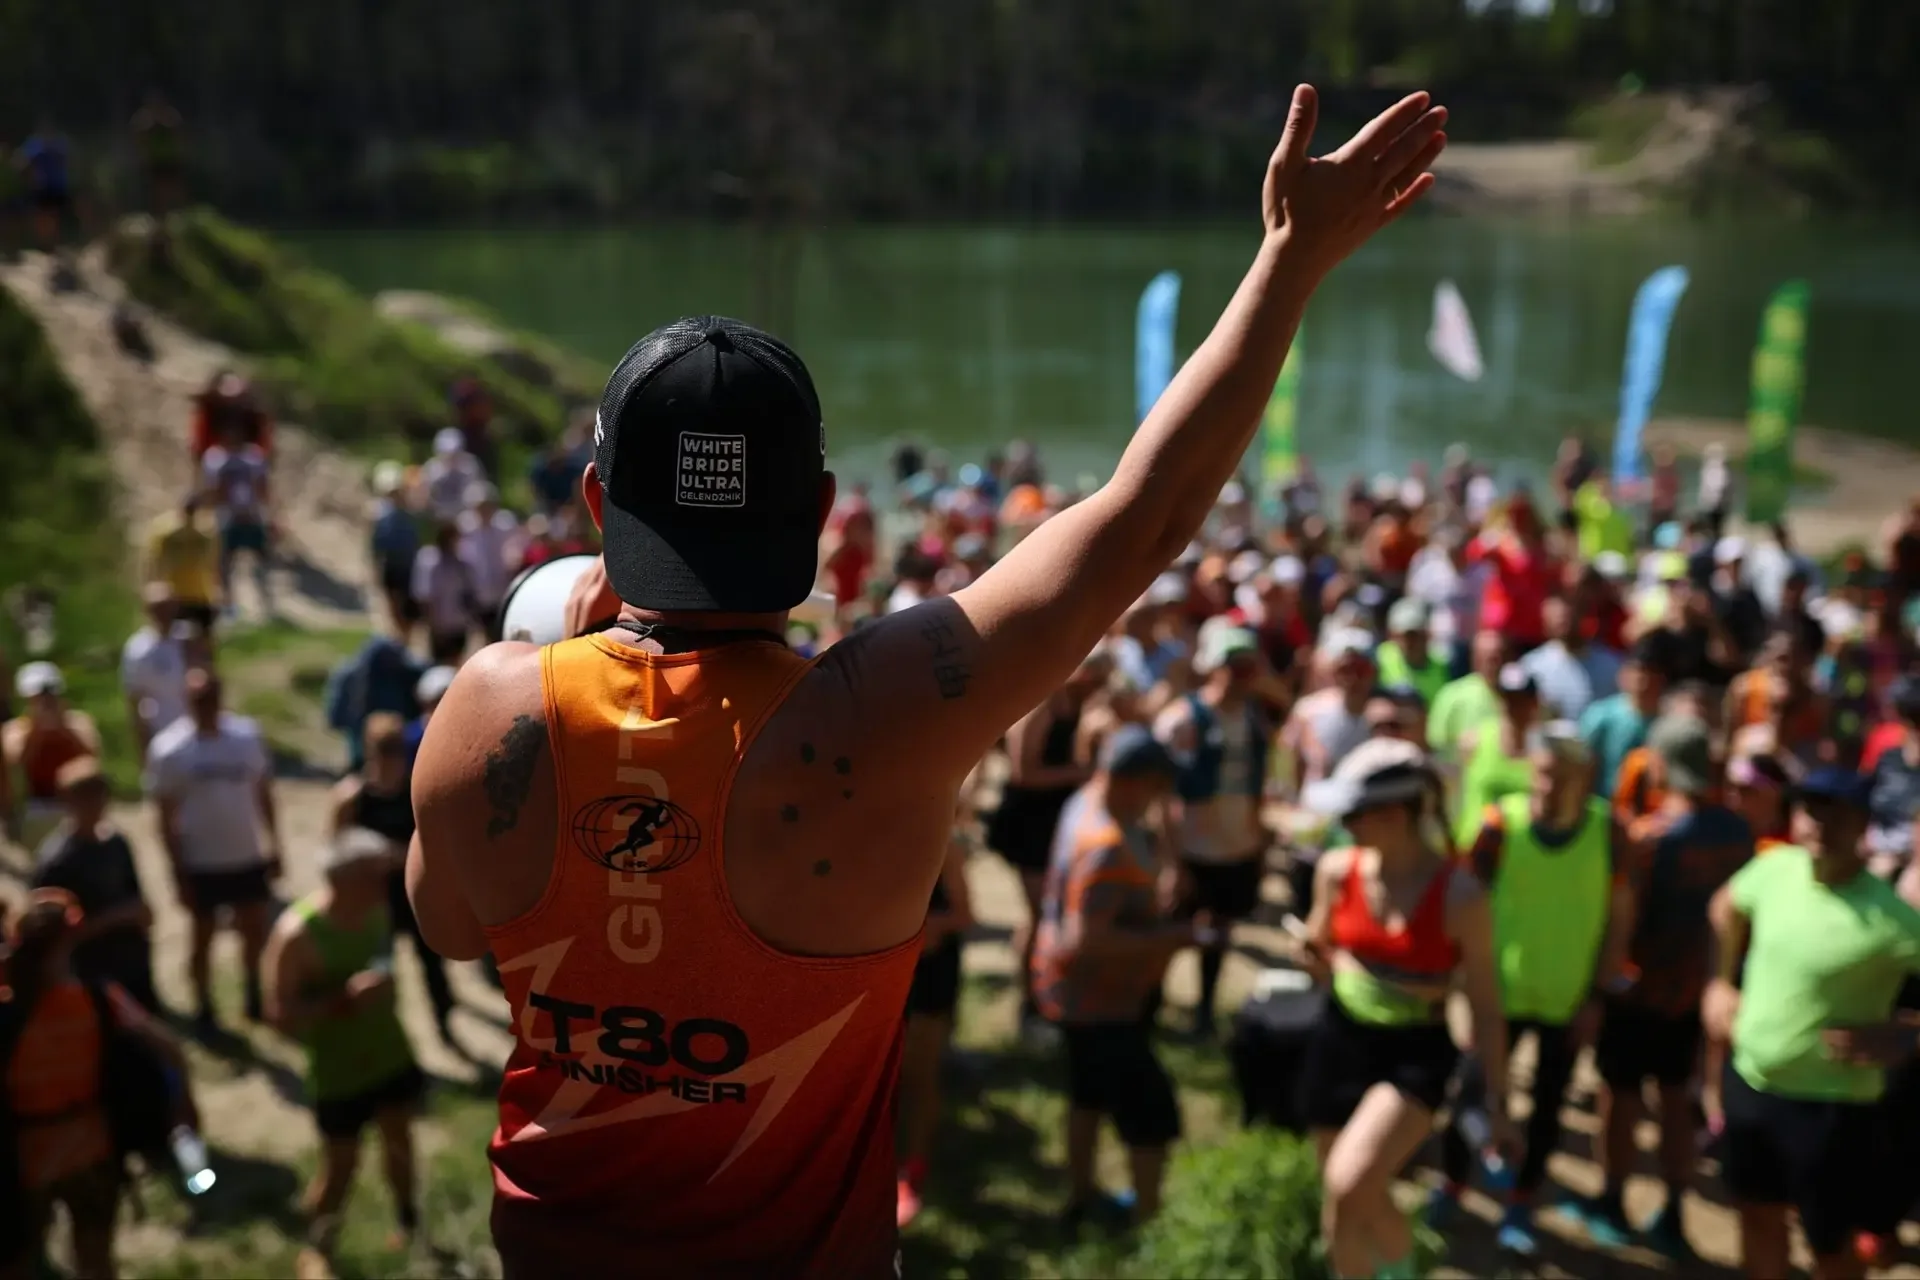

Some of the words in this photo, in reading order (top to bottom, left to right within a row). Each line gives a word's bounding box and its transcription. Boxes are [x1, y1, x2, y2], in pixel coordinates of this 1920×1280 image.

[683, 438, 742, 454] WHITE
[682, 456, 742, 472] BRIDE
[681, 474, 741, 489] ULTRA
[680, 491, 741, 501] GELENDZHIK
[530, 992, 750, 1075] T80
